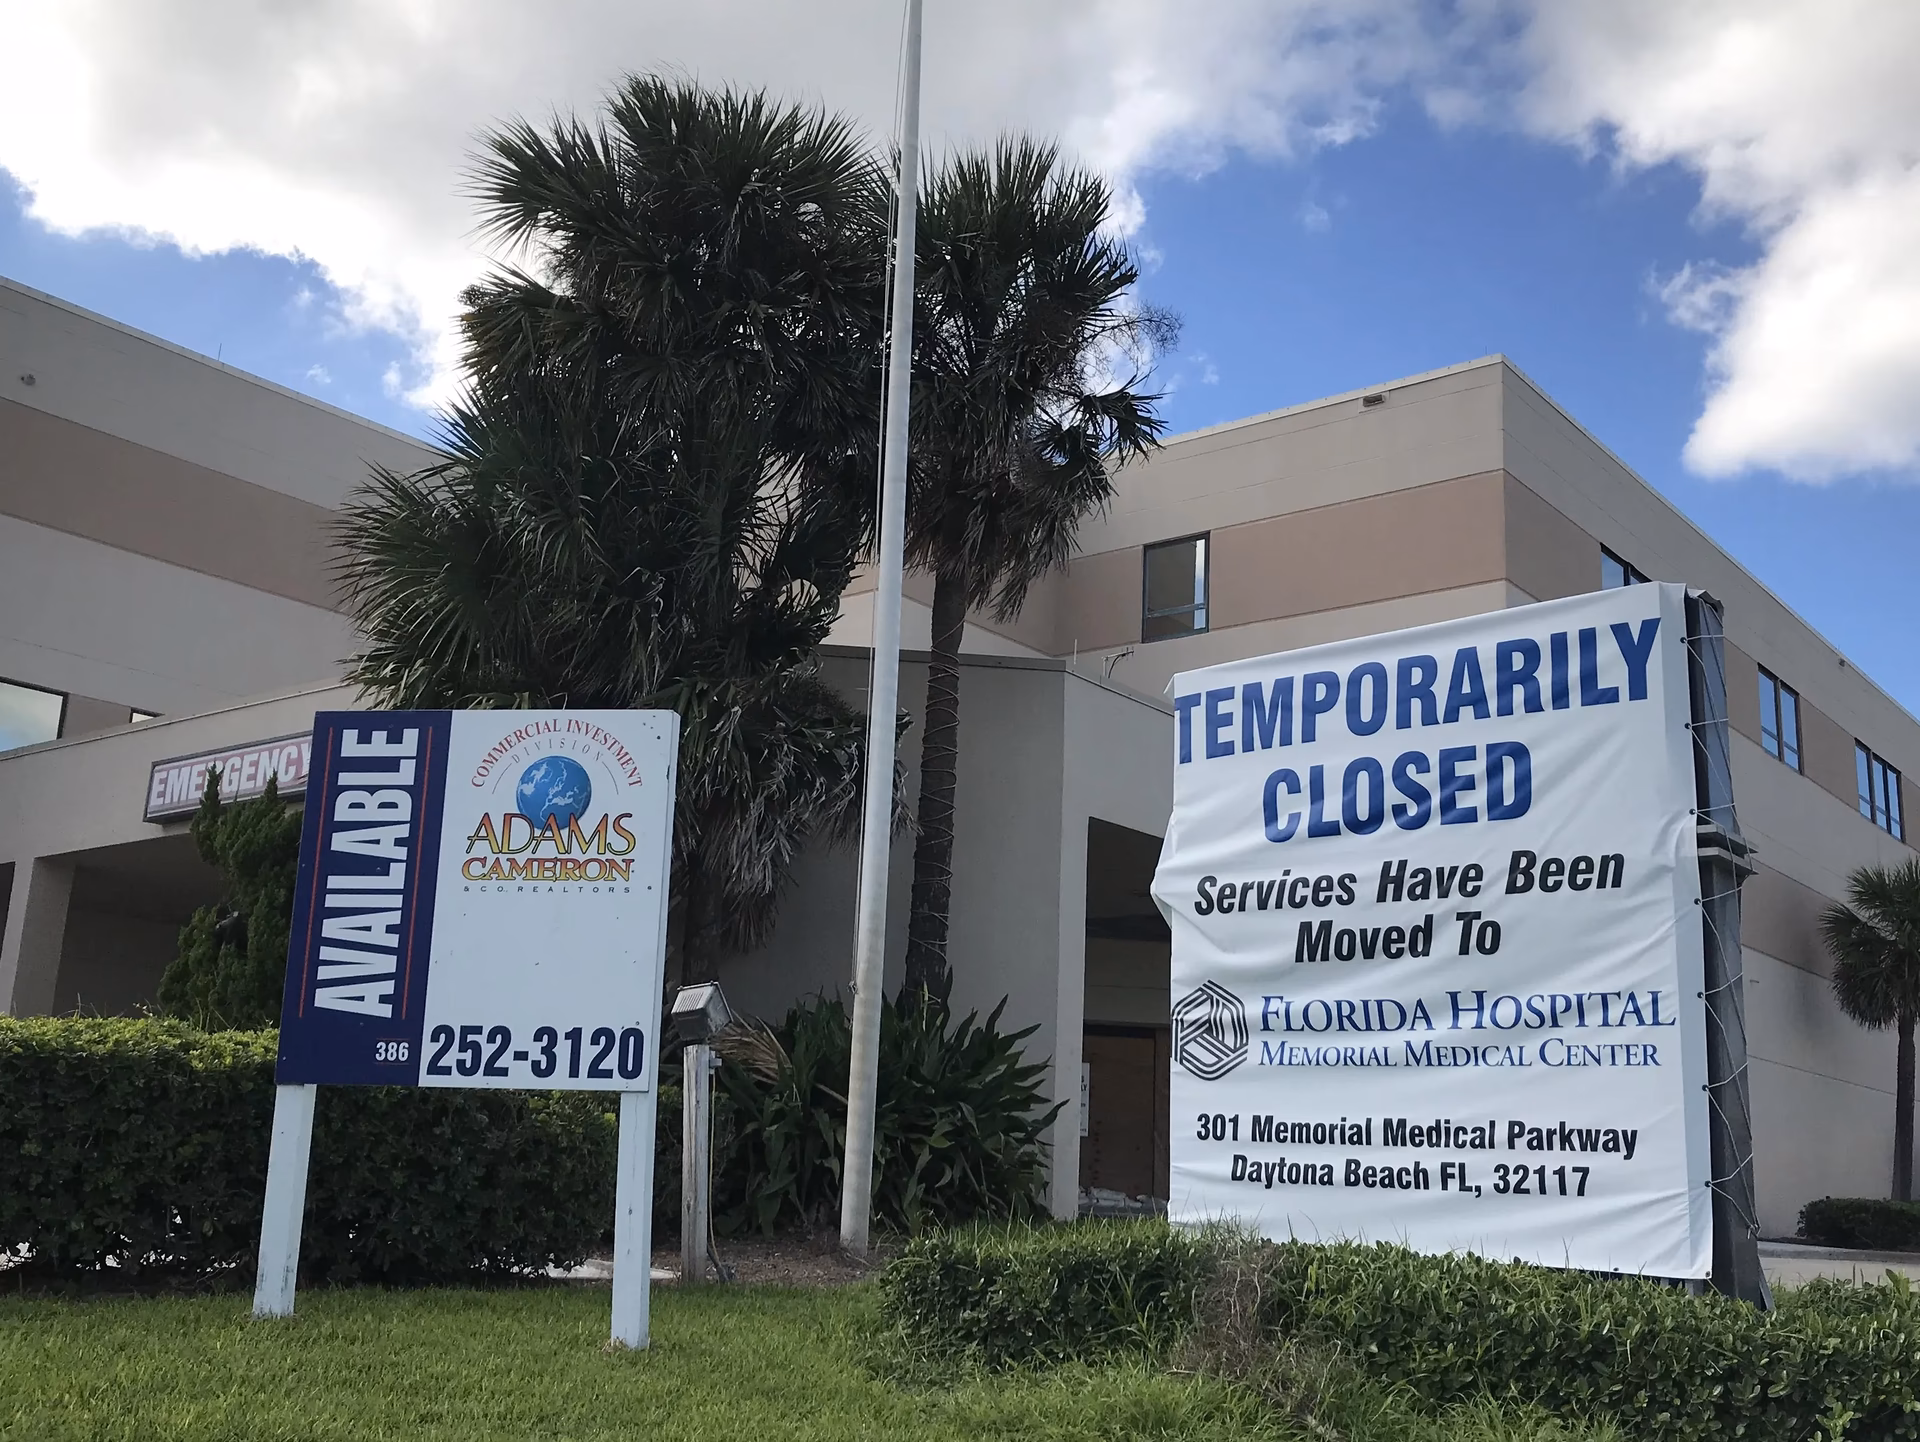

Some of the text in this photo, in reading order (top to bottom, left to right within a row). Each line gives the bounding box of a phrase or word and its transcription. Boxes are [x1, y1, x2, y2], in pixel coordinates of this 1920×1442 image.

[1174, 617, 1661, 764] TEMPORARILY
[471, 718, 643, 788] COMMERCIAL INVESTMENT
[511, 738, 603, 764] DIVISION
[1263, 741, 1532, 843] CLOSED
[465, 812, 637, 856] ADAMS
[314, 727, 420, 1018] AVAILABLE
[461, 856, 635, 882] CAMERON
[1194, 850, 1625, 916] Services Have Been
[1295, 911, 1501, 963] Moved To
[1260, 990, 1677, 1033] FLORIDA HOSPITAL
[375, 1024, 645, 1080] 386 252-3120
[1259, 1038, 1662, 1068] MEMORIAL MEDICAL CENTER
[1196, 1114, 1638, 1159] 301 Memorial Medical Parkway
[1231, 1154, 1590, 1199] Daytona Beach FL, 32117
